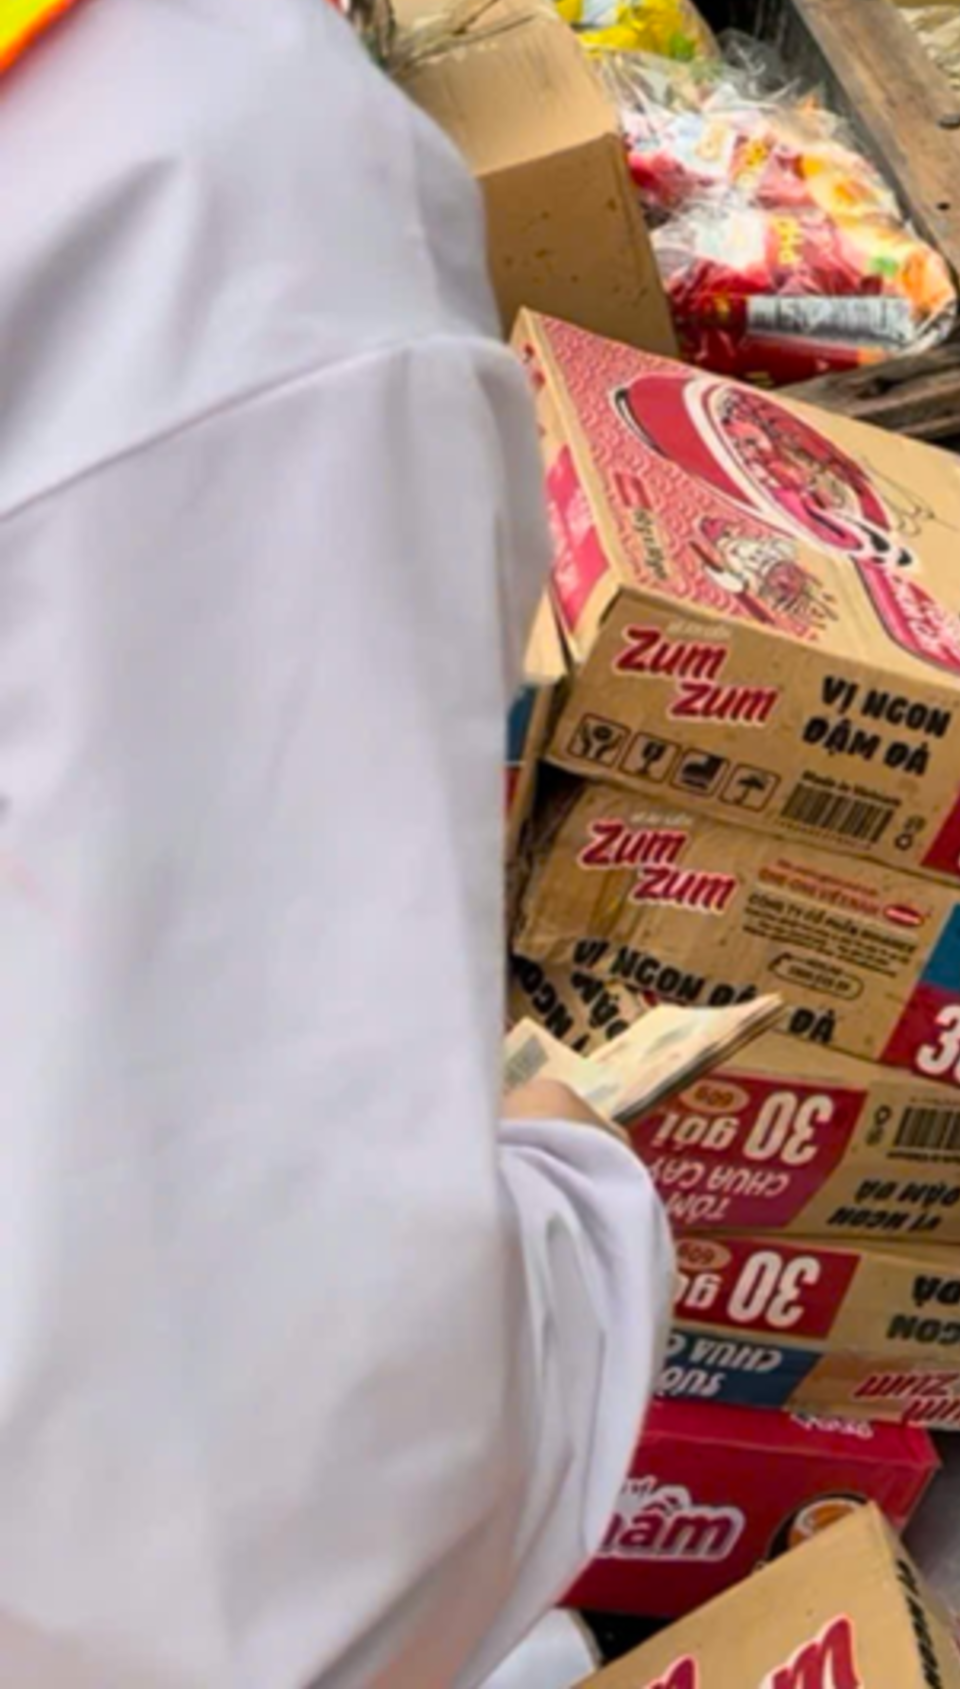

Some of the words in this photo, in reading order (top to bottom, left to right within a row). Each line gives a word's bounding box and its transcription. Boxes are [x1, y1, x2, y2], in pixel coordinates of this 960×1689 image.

[861, 688, 952, 739] NGON
[610, 947, 705, 1002] NGON
[651, 1112, 740, 1152] gói
[743, 1090, 835, 1166] 30
[706, 1163, 791, 1199] CHUA
[726, 1250, 822, 1329] 30
[688, 1336, 783, 1372] CHUA
